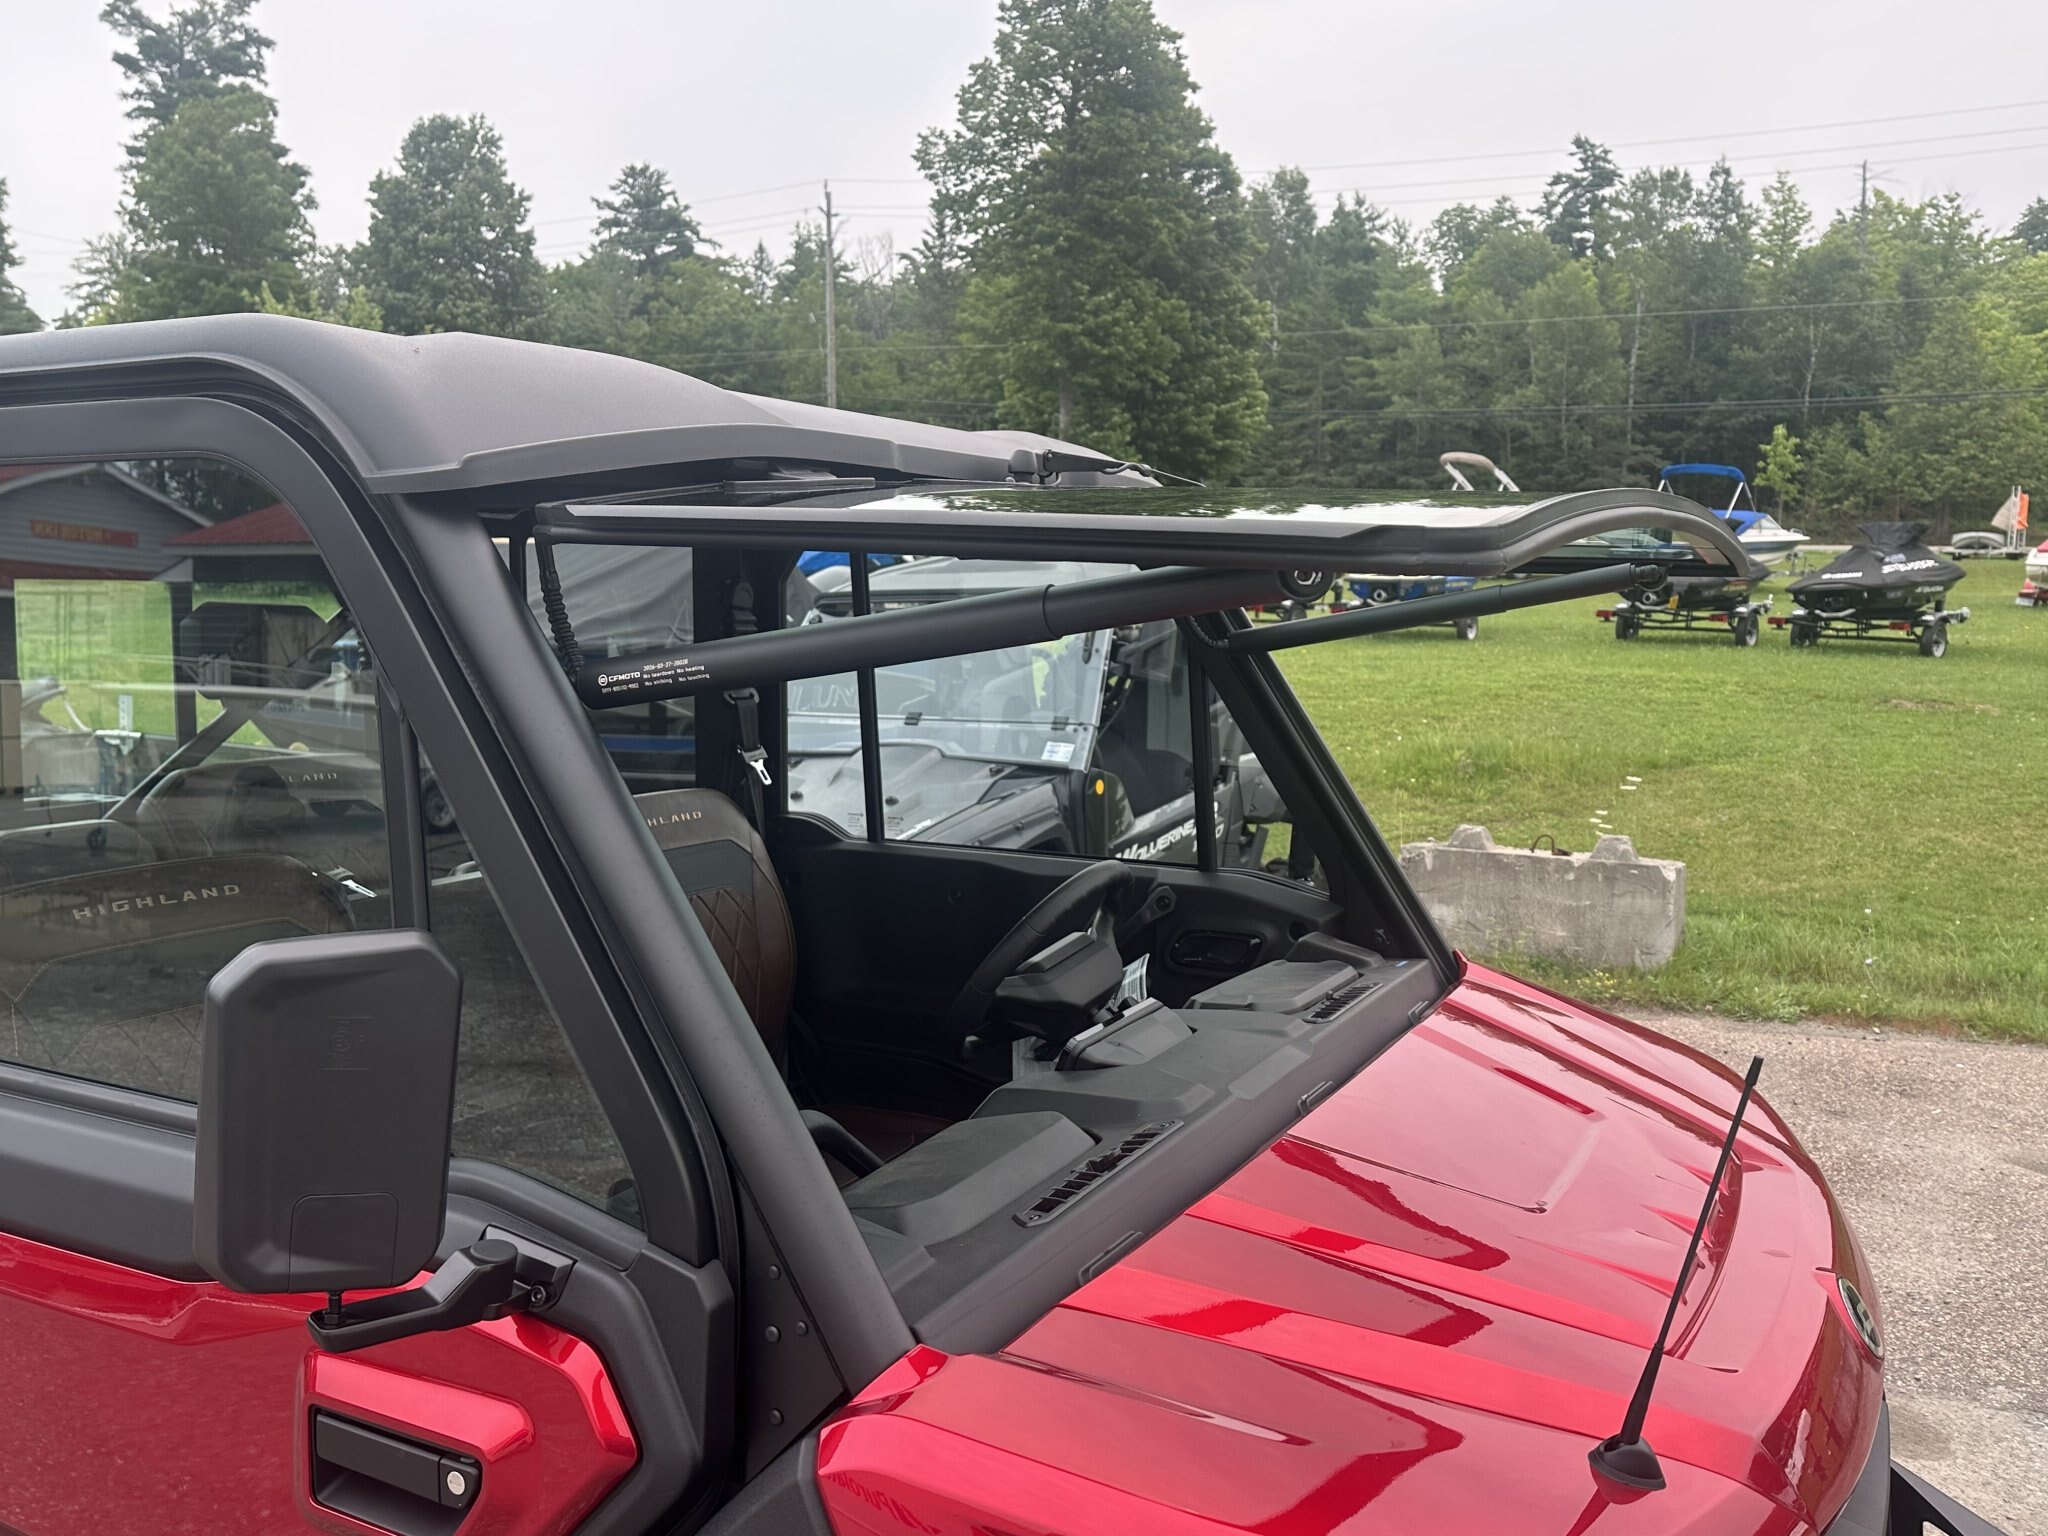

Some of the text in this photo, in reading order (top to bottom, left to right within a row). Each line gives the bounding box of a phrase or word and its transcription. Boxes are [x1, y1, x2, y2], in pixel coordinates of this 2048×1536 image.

[608, 671, 641, 682] CFMOTO
[647, 811, 702, 827] HLAND
[72, 884, 240, 920] HIGHLAND
